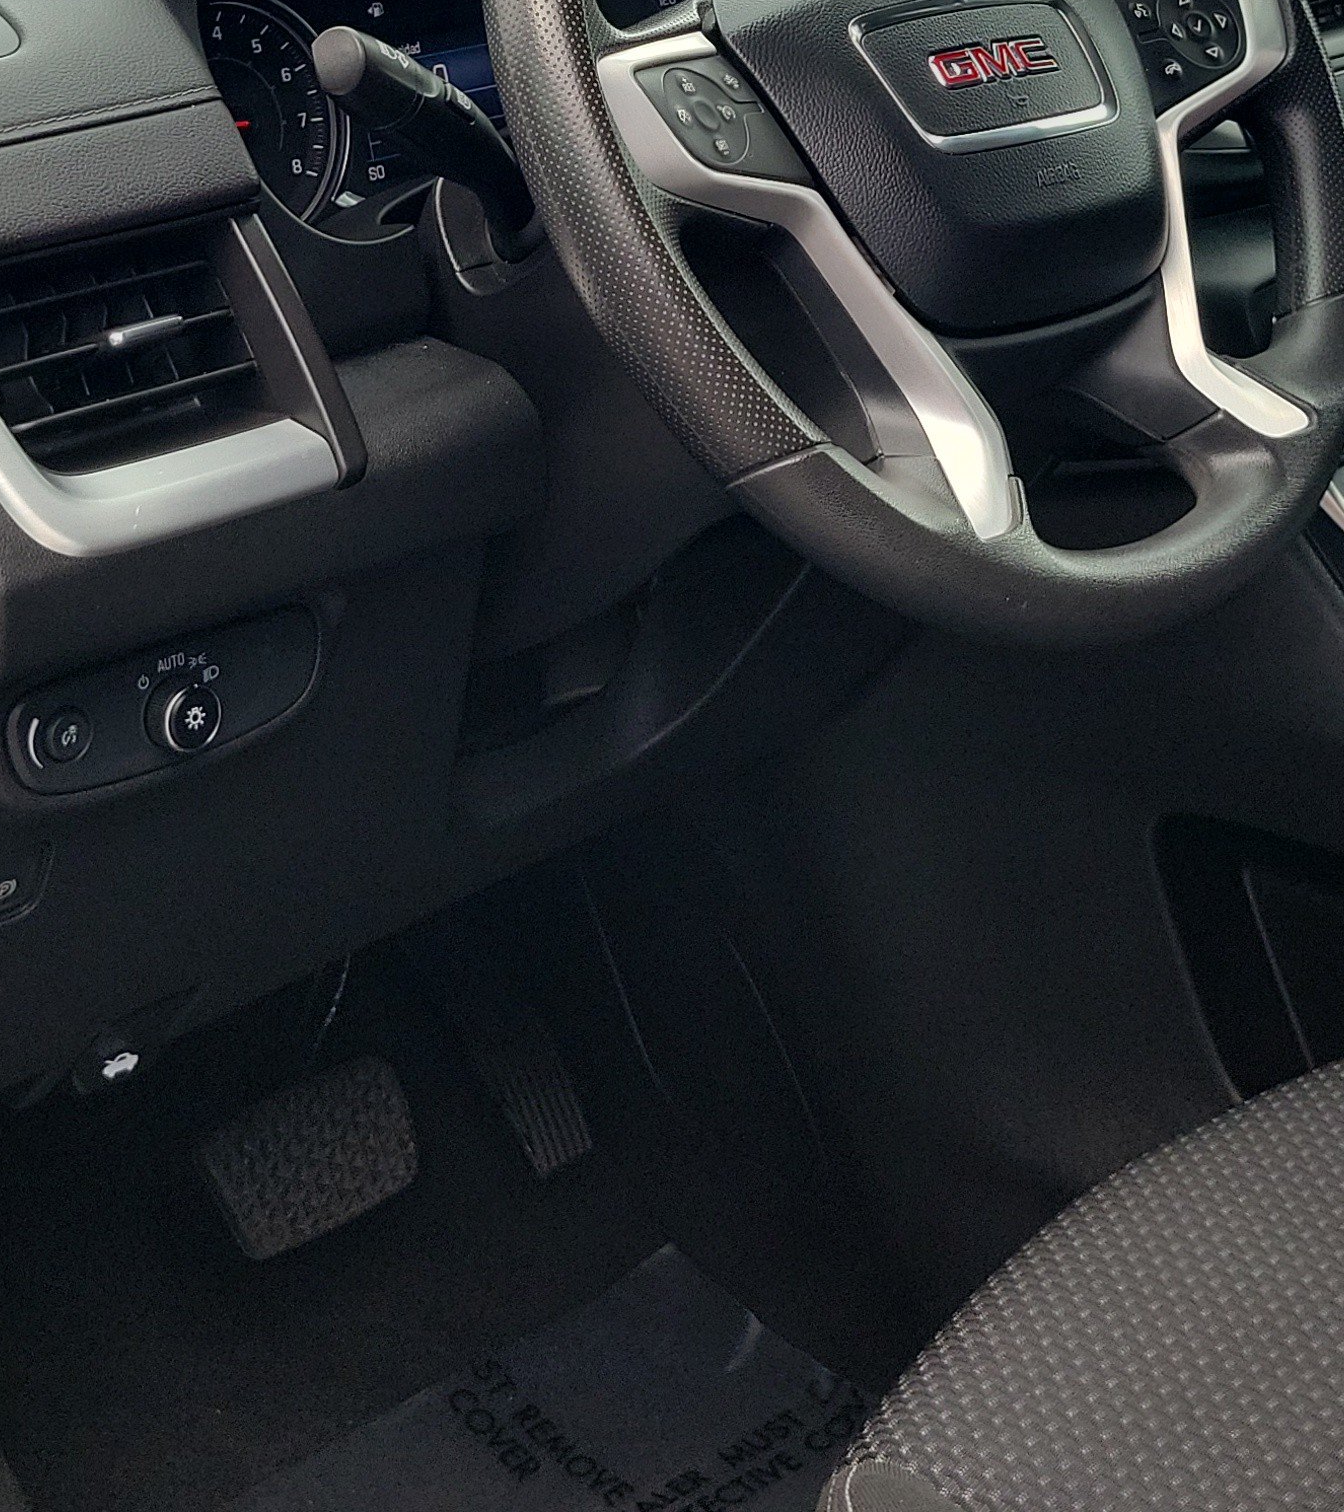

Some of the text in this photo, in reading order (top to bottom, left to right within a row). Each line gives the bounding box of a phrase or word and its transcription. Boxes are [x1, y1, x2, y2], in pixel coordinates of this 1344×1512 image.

[212, 26, 222, 41] 4
[251, 38, 262, 54] 5
[928, 37, 1059, 88] GMC
[281, 68, 292, 83] 6
[297, 112, 307, 129] 7
[291, 159, 303, 175] 8
[157, 652, 185, 673] AUTO
[448, 1389, 541, 1482] COVER
[717, 1409, 805, 1468] MUST
[511, 1404, 636, 1508] REMOVE
